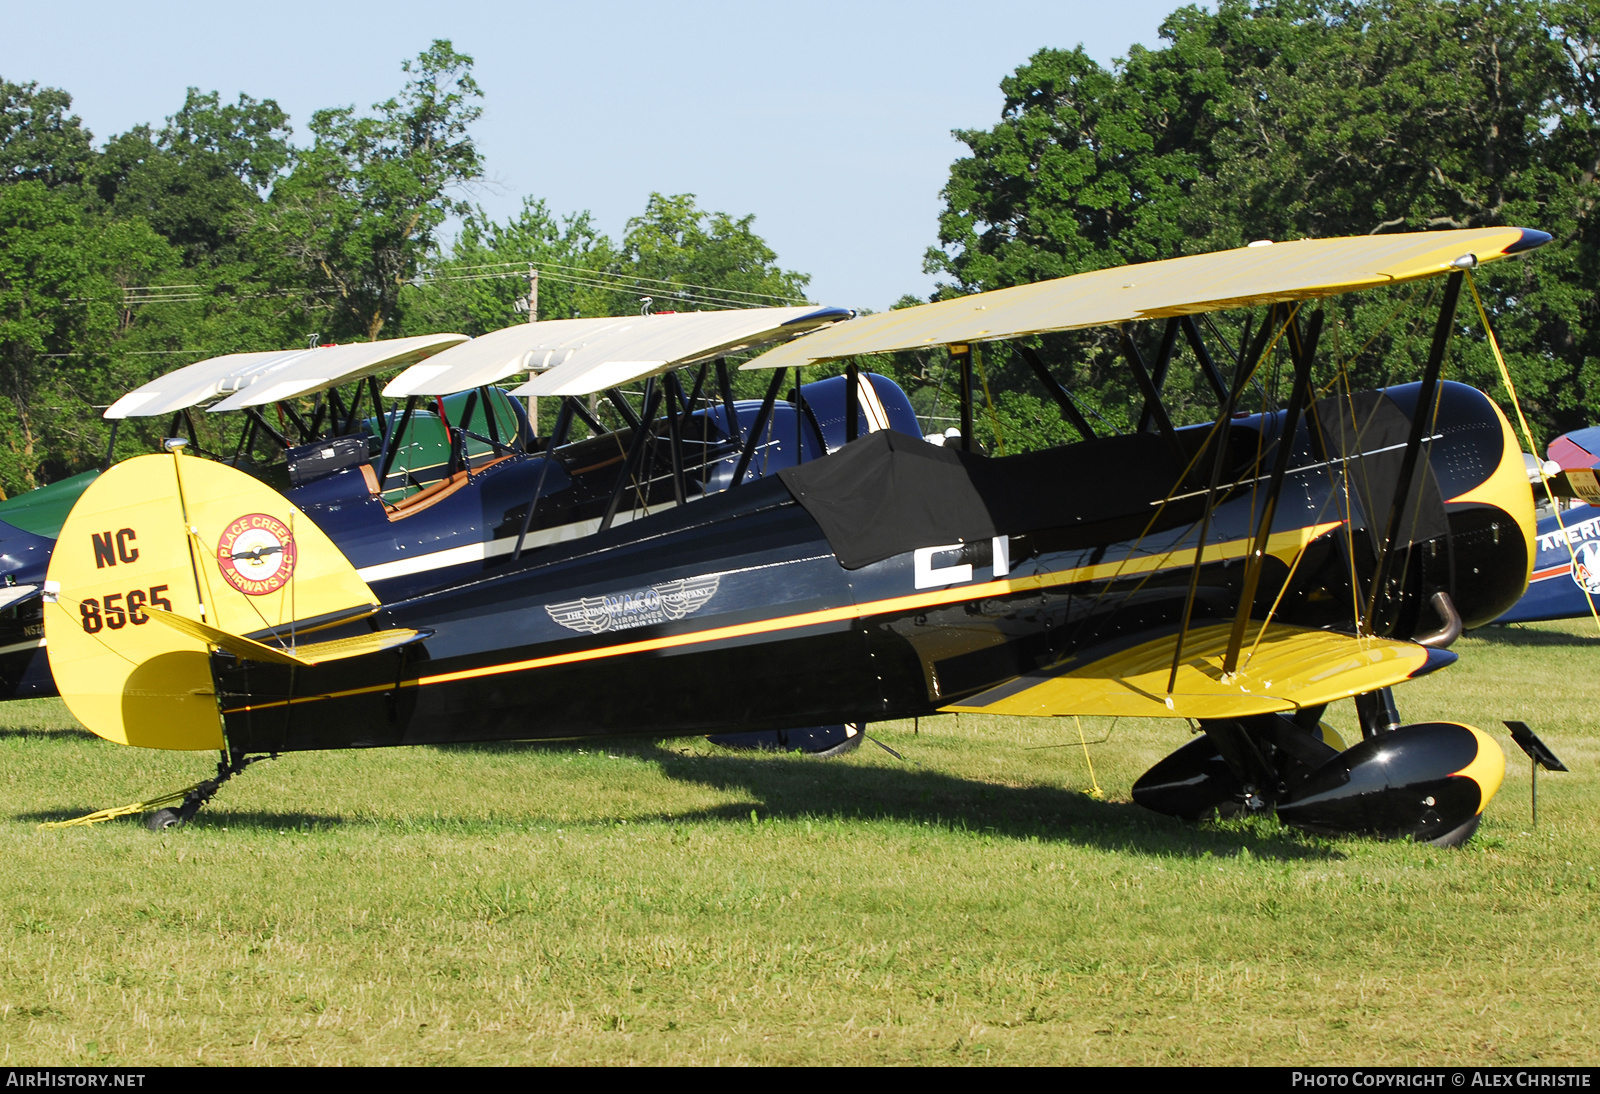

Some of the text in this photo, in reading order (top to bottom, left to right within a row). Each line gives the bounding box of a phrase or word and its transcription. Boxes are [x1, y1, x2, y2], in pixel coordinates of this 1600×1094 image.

[91, 528, 139, 569] NC
[220, 519, 250, 558] PLACE
[251, 517, 293, 547] CREEK
[225, 567, 279, 593] AIRWAYS
[276, 554, 293, 579] LLC
[79, 584, 172, 634] 8565
[566, 609, 585, 621] THE
[624, 594, 668, 611] AIRCRAFT
[668, 587, 709, 601] COMPANY
[605, 590, 660, 617] WACO
[611, 611, 663, 625] AIRPLANES
